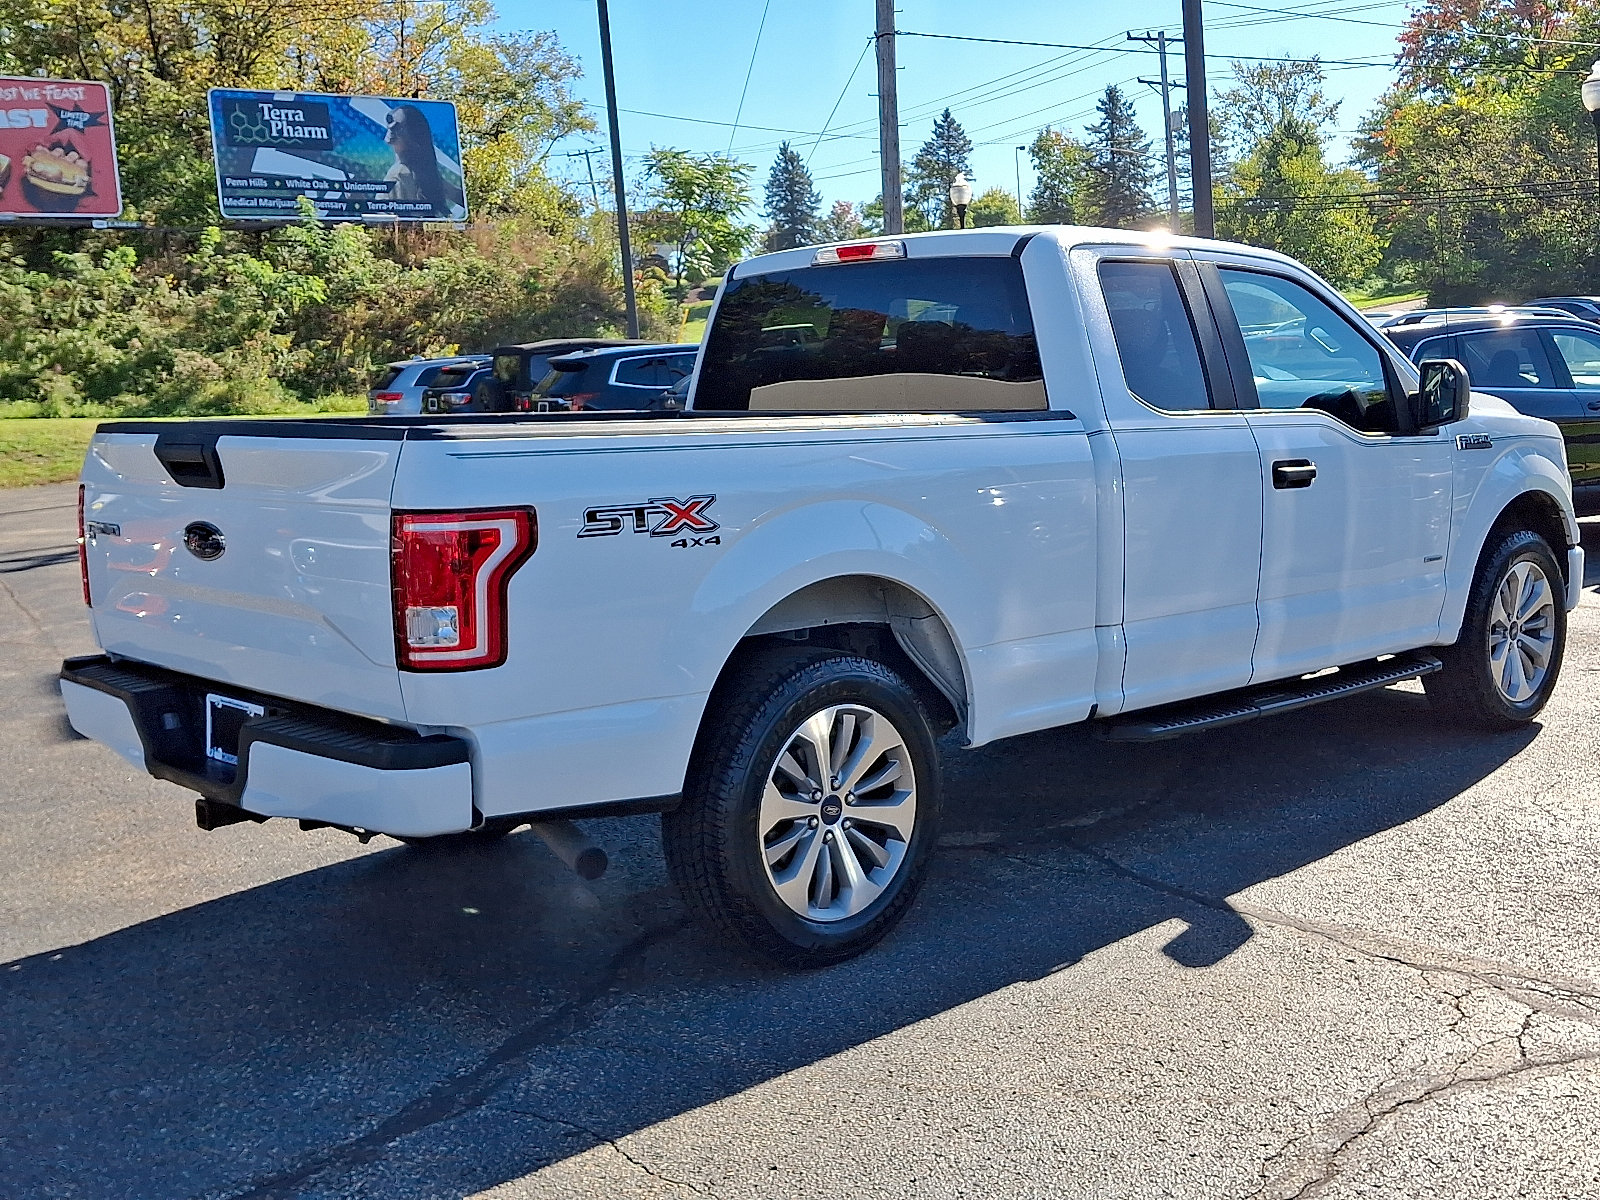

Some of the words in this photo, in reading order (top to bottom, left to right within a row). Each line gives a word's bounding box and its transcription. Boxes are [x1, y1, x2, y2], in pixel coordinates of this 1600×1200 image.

[18, 86, 41, 101] WE
[43, 84, 85, 101] FEAST
[259, 103, 304, 121] Terra
[270, 120, 328, 139] Pharm
[225, 178, 248, 187] Penn
[249, 178, 268, 188] Hills
[285, 179, 311, 189] White
[312, 180, 330, 190] Oak
[343, 182, 387, 191] Uniontown
[223, 197, 257, 206] Medical
[258, 198, 298, 209] Marijuan
[366, 201, 432, 211] Terra-Pharm.com
[577, 494, 720, 538] STX
